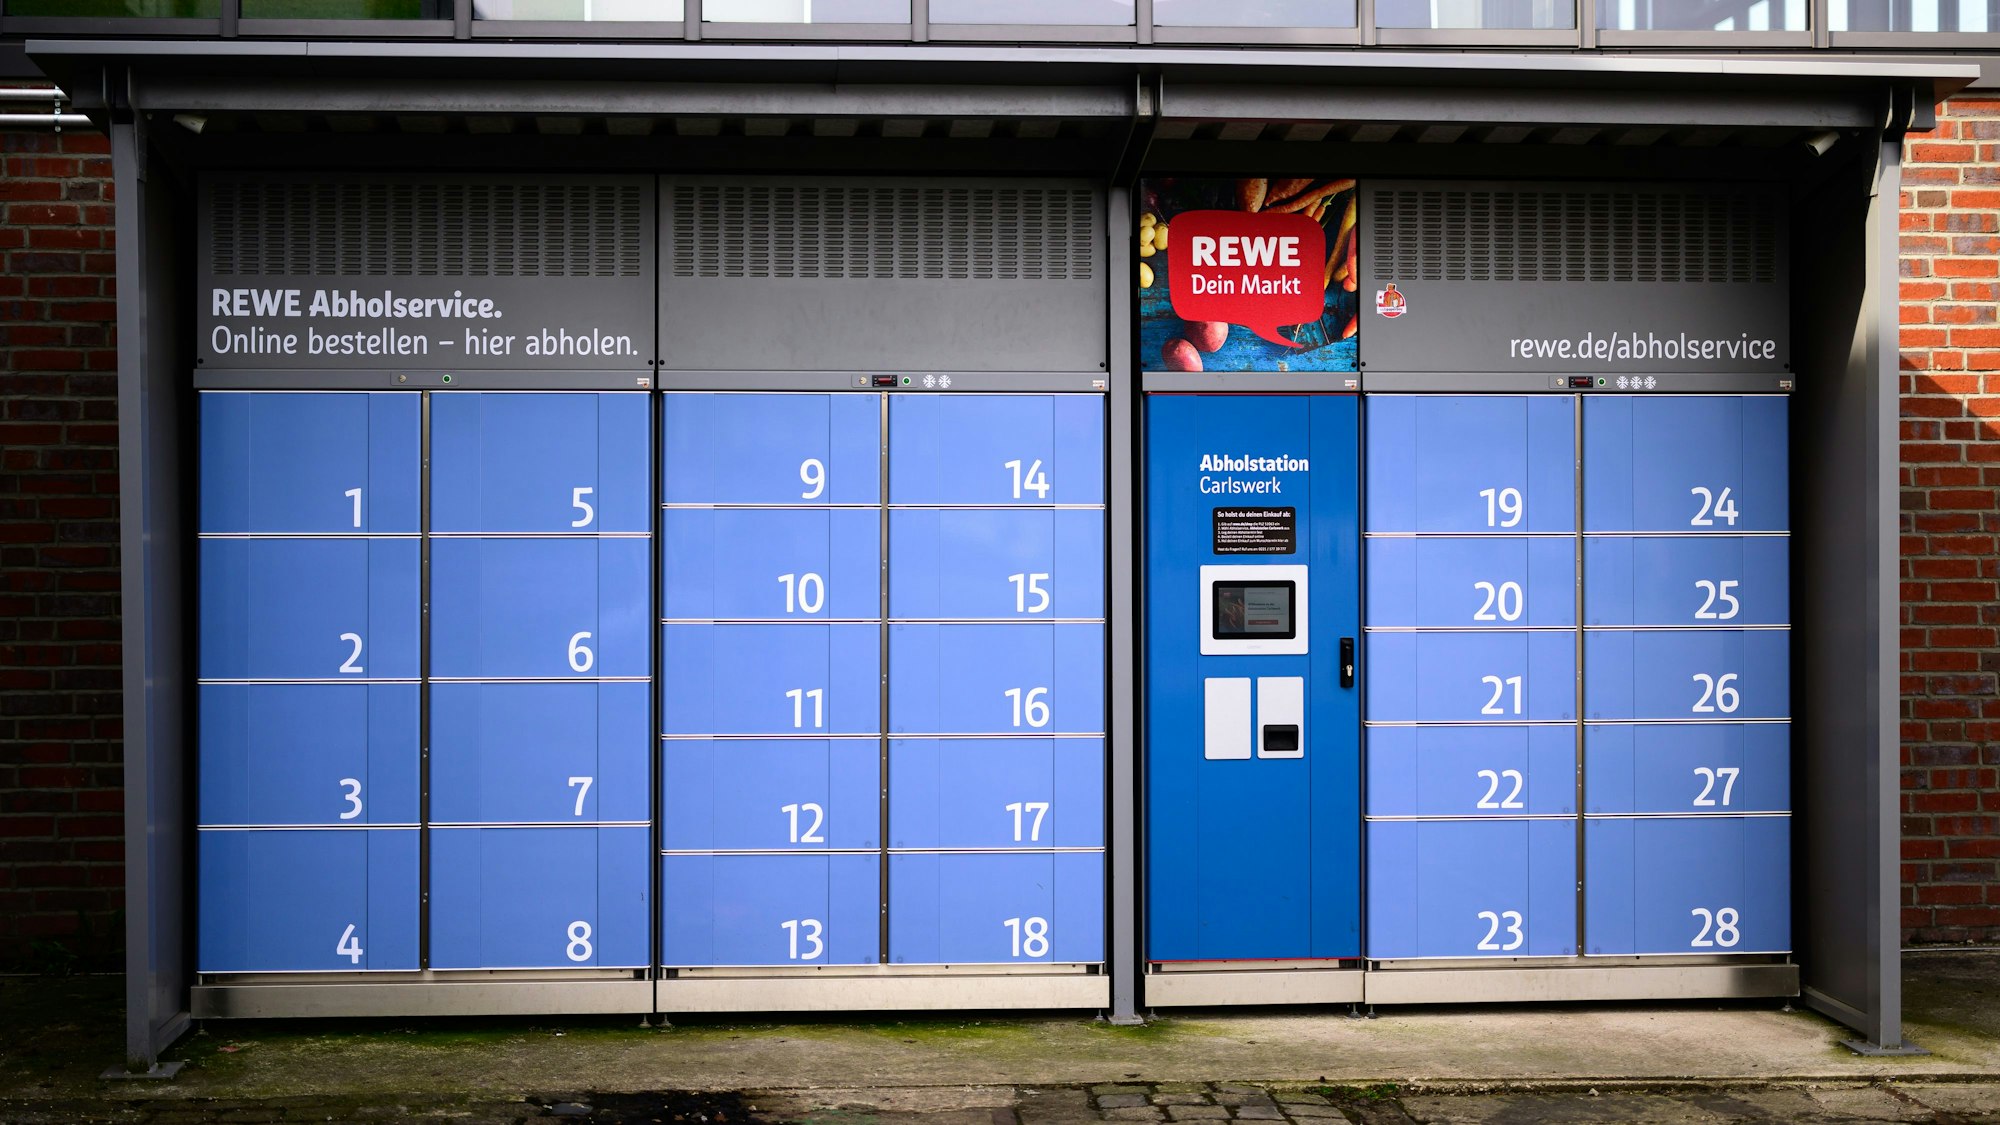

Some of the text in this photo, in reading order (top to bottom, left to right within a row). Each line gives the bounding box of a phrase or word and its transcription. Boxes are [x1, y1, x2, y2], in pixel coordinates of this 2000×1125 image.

[1192, 236, 1301, 267] REWE
[212, 288, 503, 319] REWE Abholservice.
[1191, 273, 1301, 295] Dein Markt
[211, 325, 298, 355] Online
[308, 326, 428, 356] bestellen
[465, 327, 516, 356] hier
[525, 327, 639, 357] abholen.
[1509, 331, 1777, 363] rewe.de/abholservice
[799, 458, 826, 500] 9
[1004, 458, 1051, 499] 14
[1199, 453, 1309, 472] Abholstation
[1199, 475, 1281, 494] Carlswerk
[344, 487, 362, 528] 1
[571, 486, 594, 528] 5
[1479, 487, 1523, 528] 19
[1690, 486, 1739, 526] 24
[777, 572, 825, 614] 10
[1007, 572, 1050, 614] 15
[1473, 580, 1524, 622] 20
[1694, 579, 1740, 620] 25
[339, 632, 363, 673] 2
[568, 631, 594, 673] 6
[785, 688, 823, 728] 11
[1004, 686, 1050, 728] 16
[1480, 674, 1522, 715] 21
[1692, 673, 1740, 713] 26
[339, 778, 363, 820] 3
[568, 776, 593, 816] 7
[1476, 769, 1524, 809] 22
[1693, 766, 1740, 807] 27
[781, 802, 825, 844] 12
[1005, 801, 1050, 842] 17
[336, 923, 364, 964] 4
[566, 920, 593, 962] 8
[780, 918, 826, 960] 13
[1003, 916, 1050, 958] 18
[1476, 910, 1524, 951] 23
[1690, 907, 1740, 948] 28
